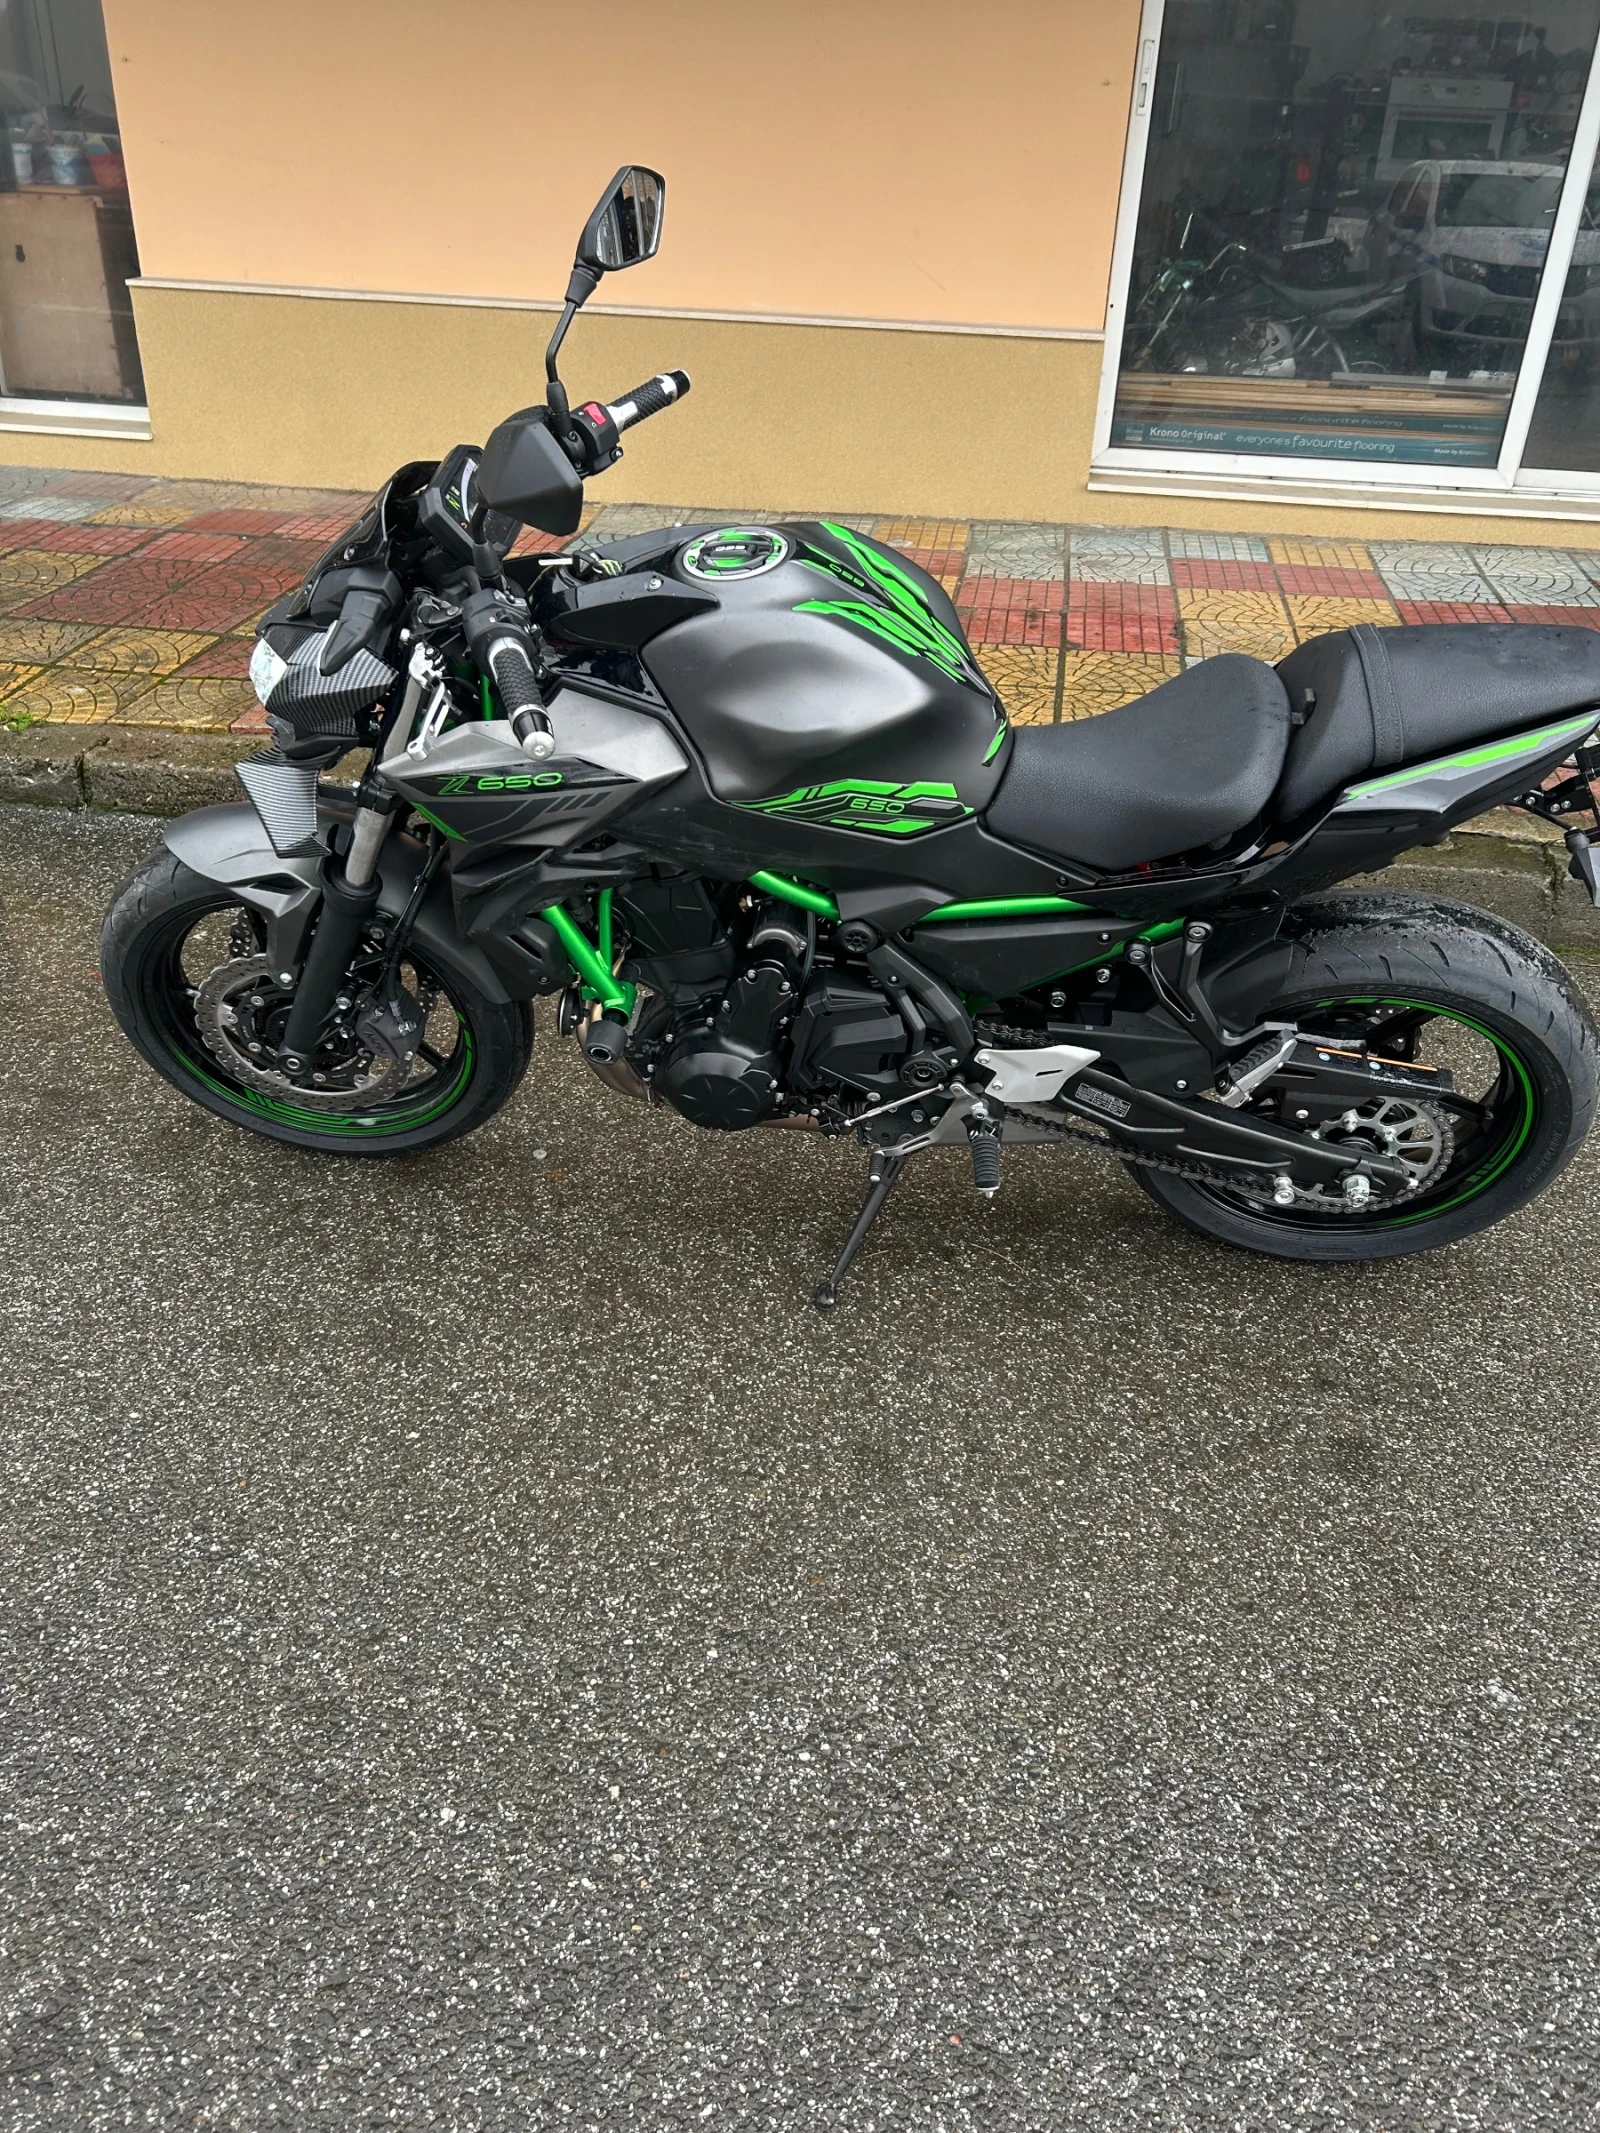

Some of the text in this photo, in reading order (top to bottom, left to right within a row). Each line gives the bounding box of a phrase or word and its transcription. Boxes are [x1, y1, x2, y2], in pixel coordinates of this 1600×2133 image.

[1149, 426, 1180, 437] Krono
[1236, 433, 1396, 453] everyone's favourite flooring
[1434, 447, 1450, 455] Made
[1451, 448, 1458, 456] by
[477, 772, 563, 791] 650
[849, 799, 905, 814] 650
